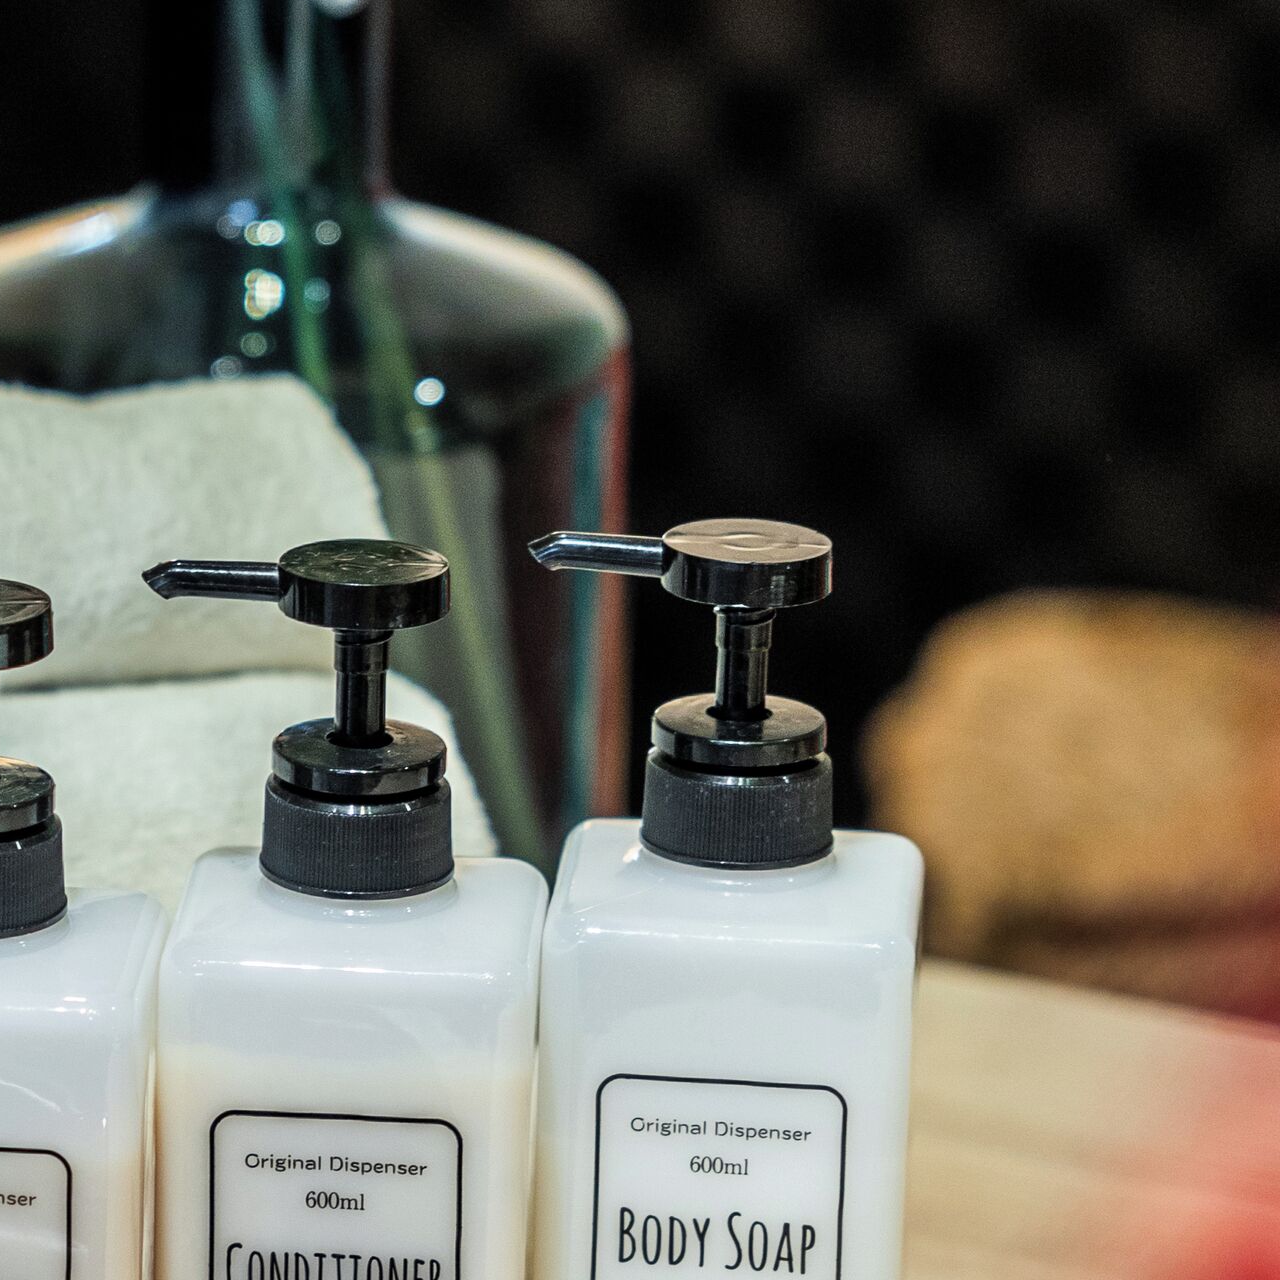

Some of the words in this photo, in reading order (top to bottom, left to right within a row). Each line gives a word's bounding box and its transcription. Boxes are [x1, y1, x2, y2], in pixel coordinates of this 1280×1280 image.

[630, 1117, 707, 1137] Original
[715, 1121, 812, 1141] Dispenser
[244, 1153, 322, 1172] Original
[330, 1156, 428, 1176] Dispenser
[689, 1155, 748, 1176] 600ml
[305, 1190, 365, 1211] 600ml
[618, 1206, 710, 1268] BODY
[724, 1211, 816, 1275] SOAP
